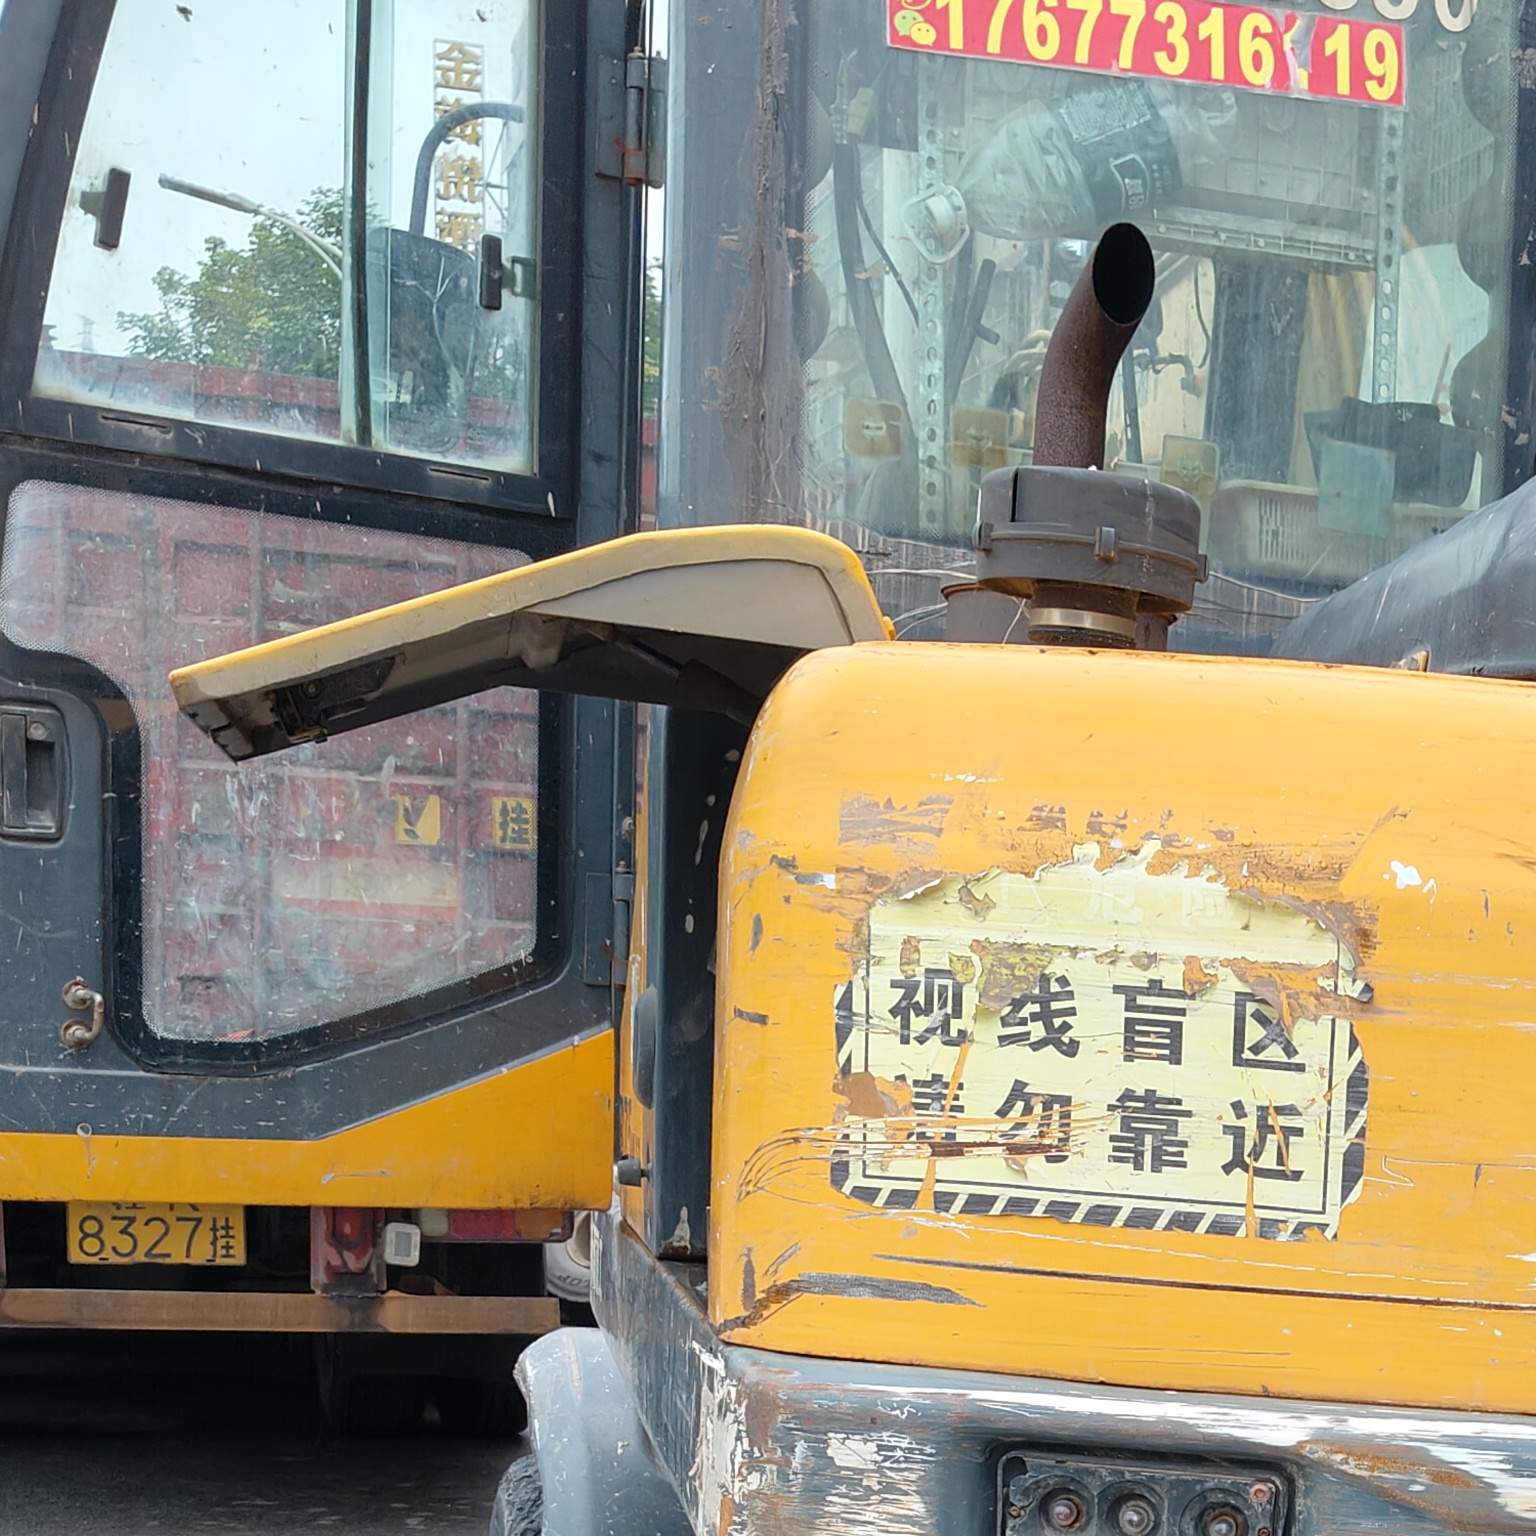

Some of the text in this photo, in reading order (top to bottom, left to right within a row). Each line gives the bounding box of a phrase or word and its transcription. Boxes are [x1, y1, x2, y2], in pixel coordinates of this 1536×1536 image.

[935, 0, 1403, 101] 1767731619
[888, 968, 1306, 1073] 视线盲区
[78, 1214, 236, 1259] 8327挂
